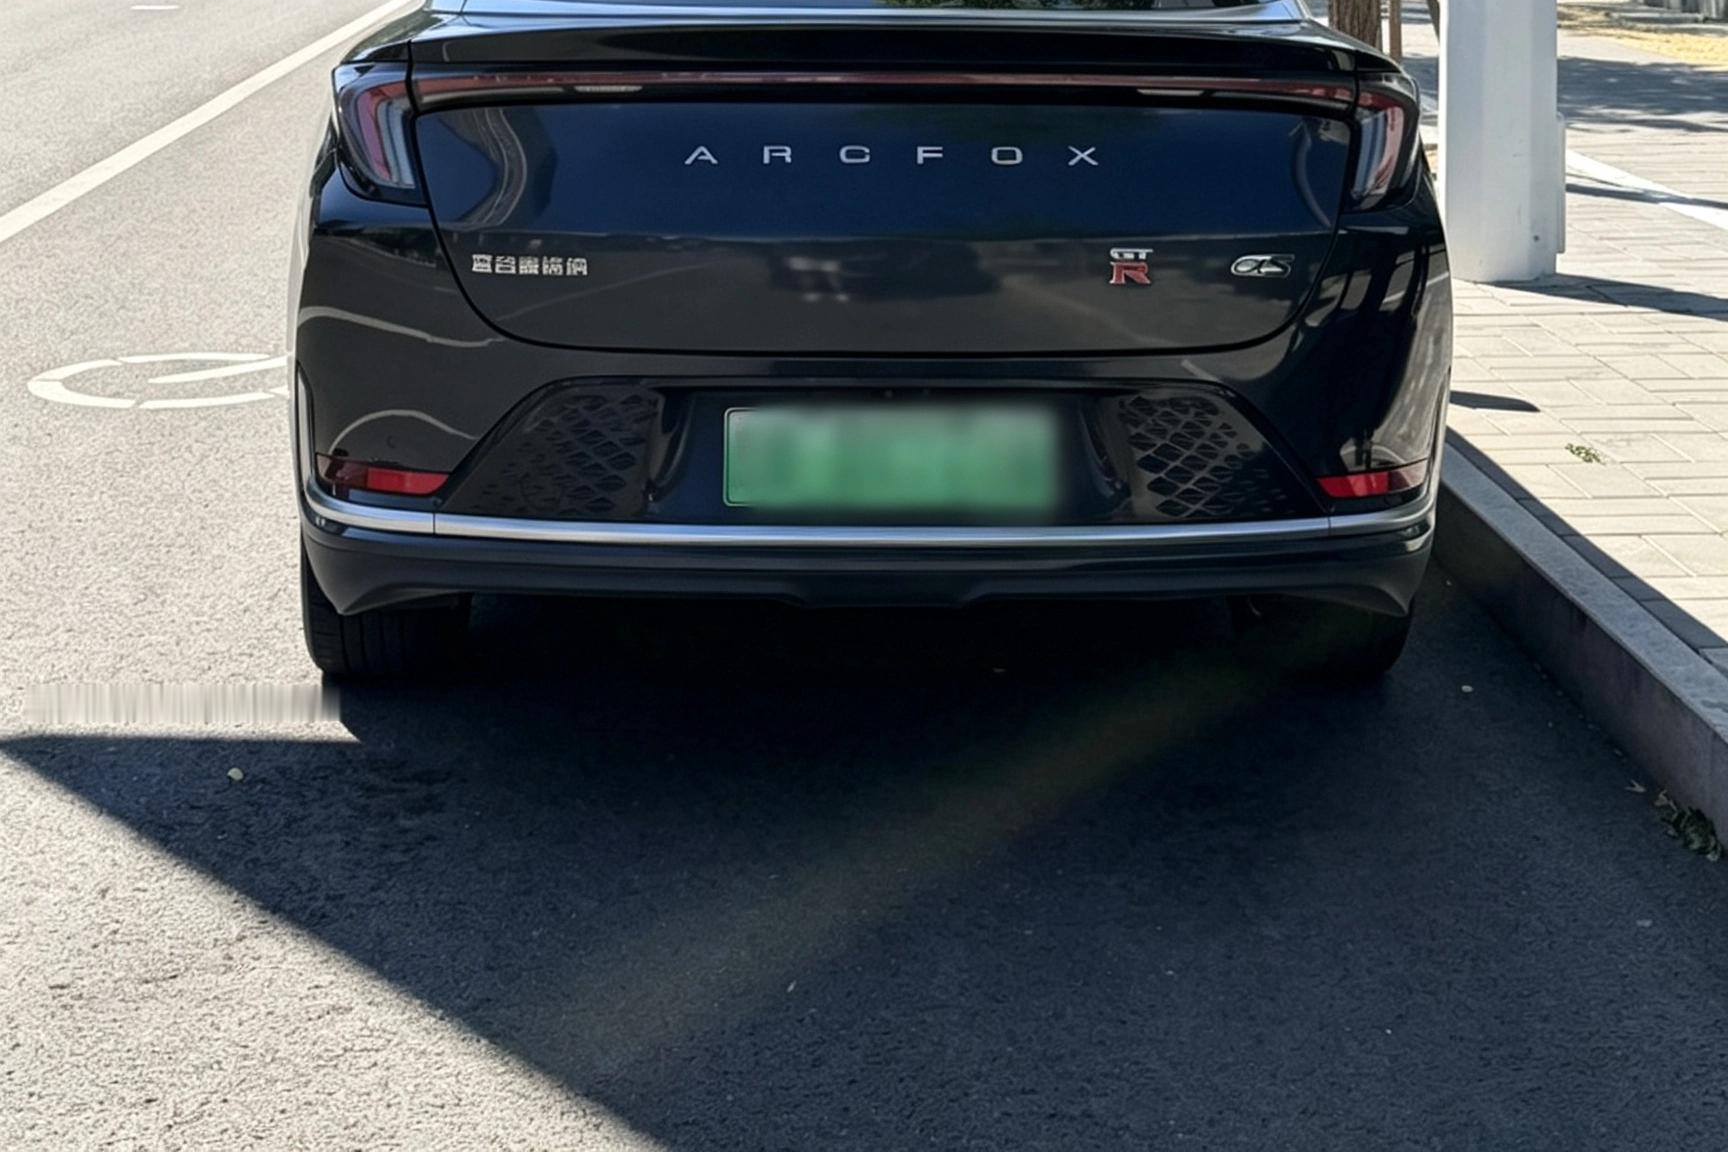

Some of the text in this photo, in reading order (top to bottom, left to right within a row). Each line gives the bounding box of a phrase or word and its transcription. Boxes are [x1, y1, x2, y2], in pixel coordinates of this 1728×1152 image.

[684, 146, 1099, 166] ARCFOX
[1110, 248, 1153, 259] GT
[1109, 261, 1151, 284] R
